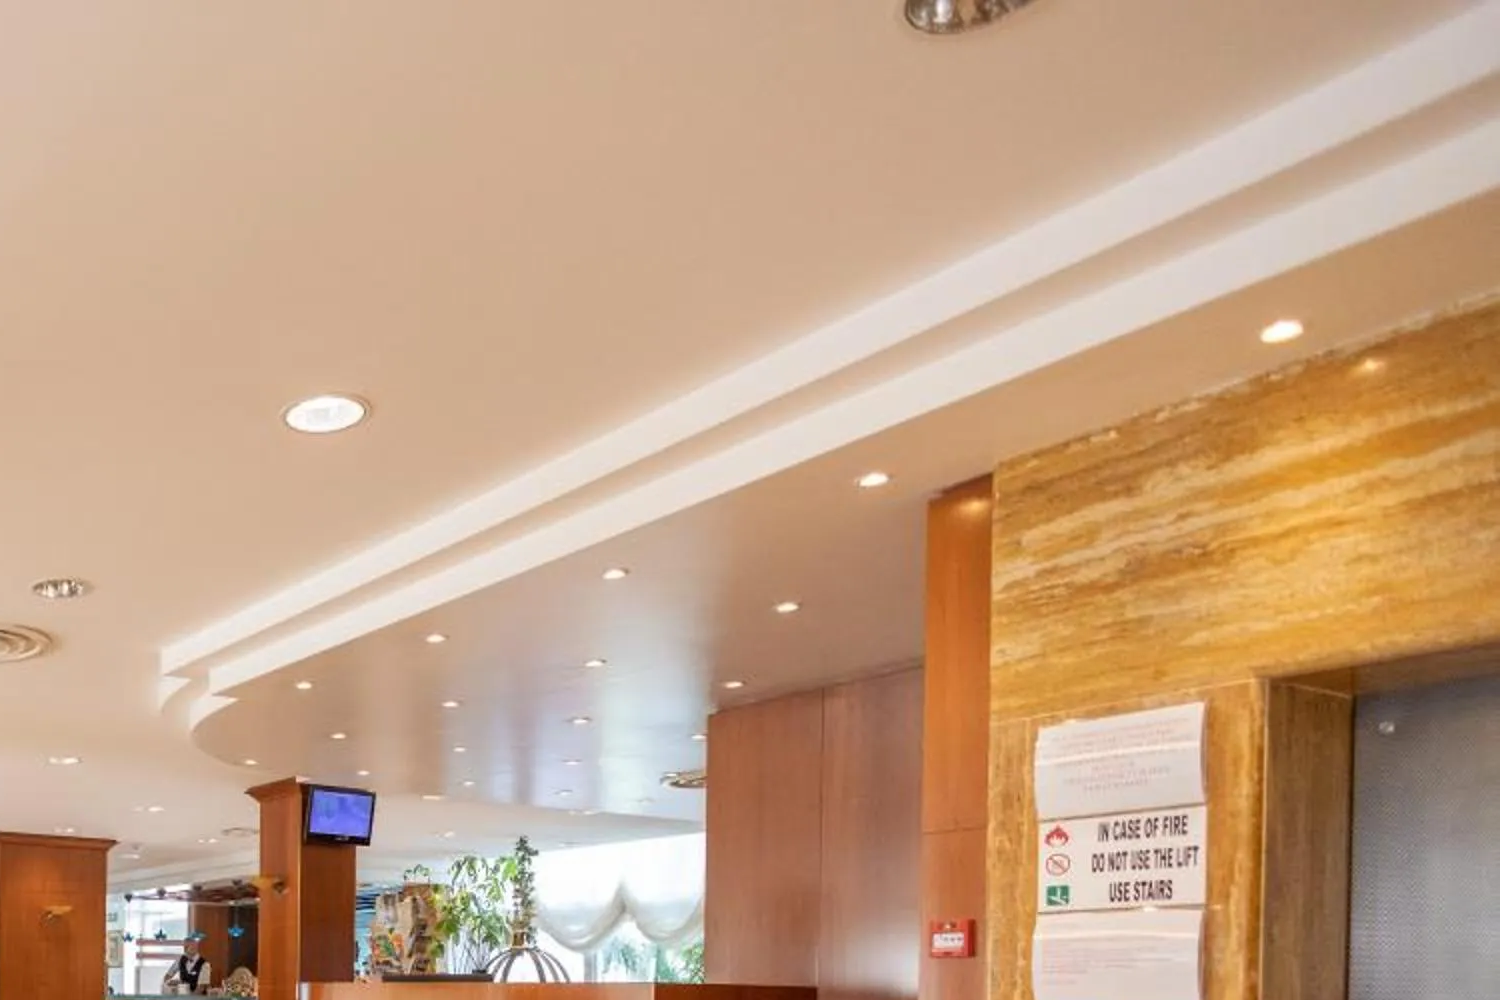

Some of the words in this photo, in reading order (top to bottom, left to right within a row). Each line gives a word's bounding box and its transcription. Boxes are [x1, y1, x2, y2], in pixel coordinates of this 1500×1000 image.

[1098, 822, 1109, 842] IN
[1113, 819, 1141, 841] CASE
[1143, 817, 1159, 838] OF
[1162, 815, 1189, 837] FIRE
[1091, 853, 1105, 873] DO
[1107, 851, 1128, 871] NOT
[1131, 850, 1150, 870] USE
[1154, 848, 1173, 869] THE
[1176, 846, 1199, 867] LIFT
[1109, 881, 1130, 902] USE
[1133, 880, 1173, 901] STAIRS
